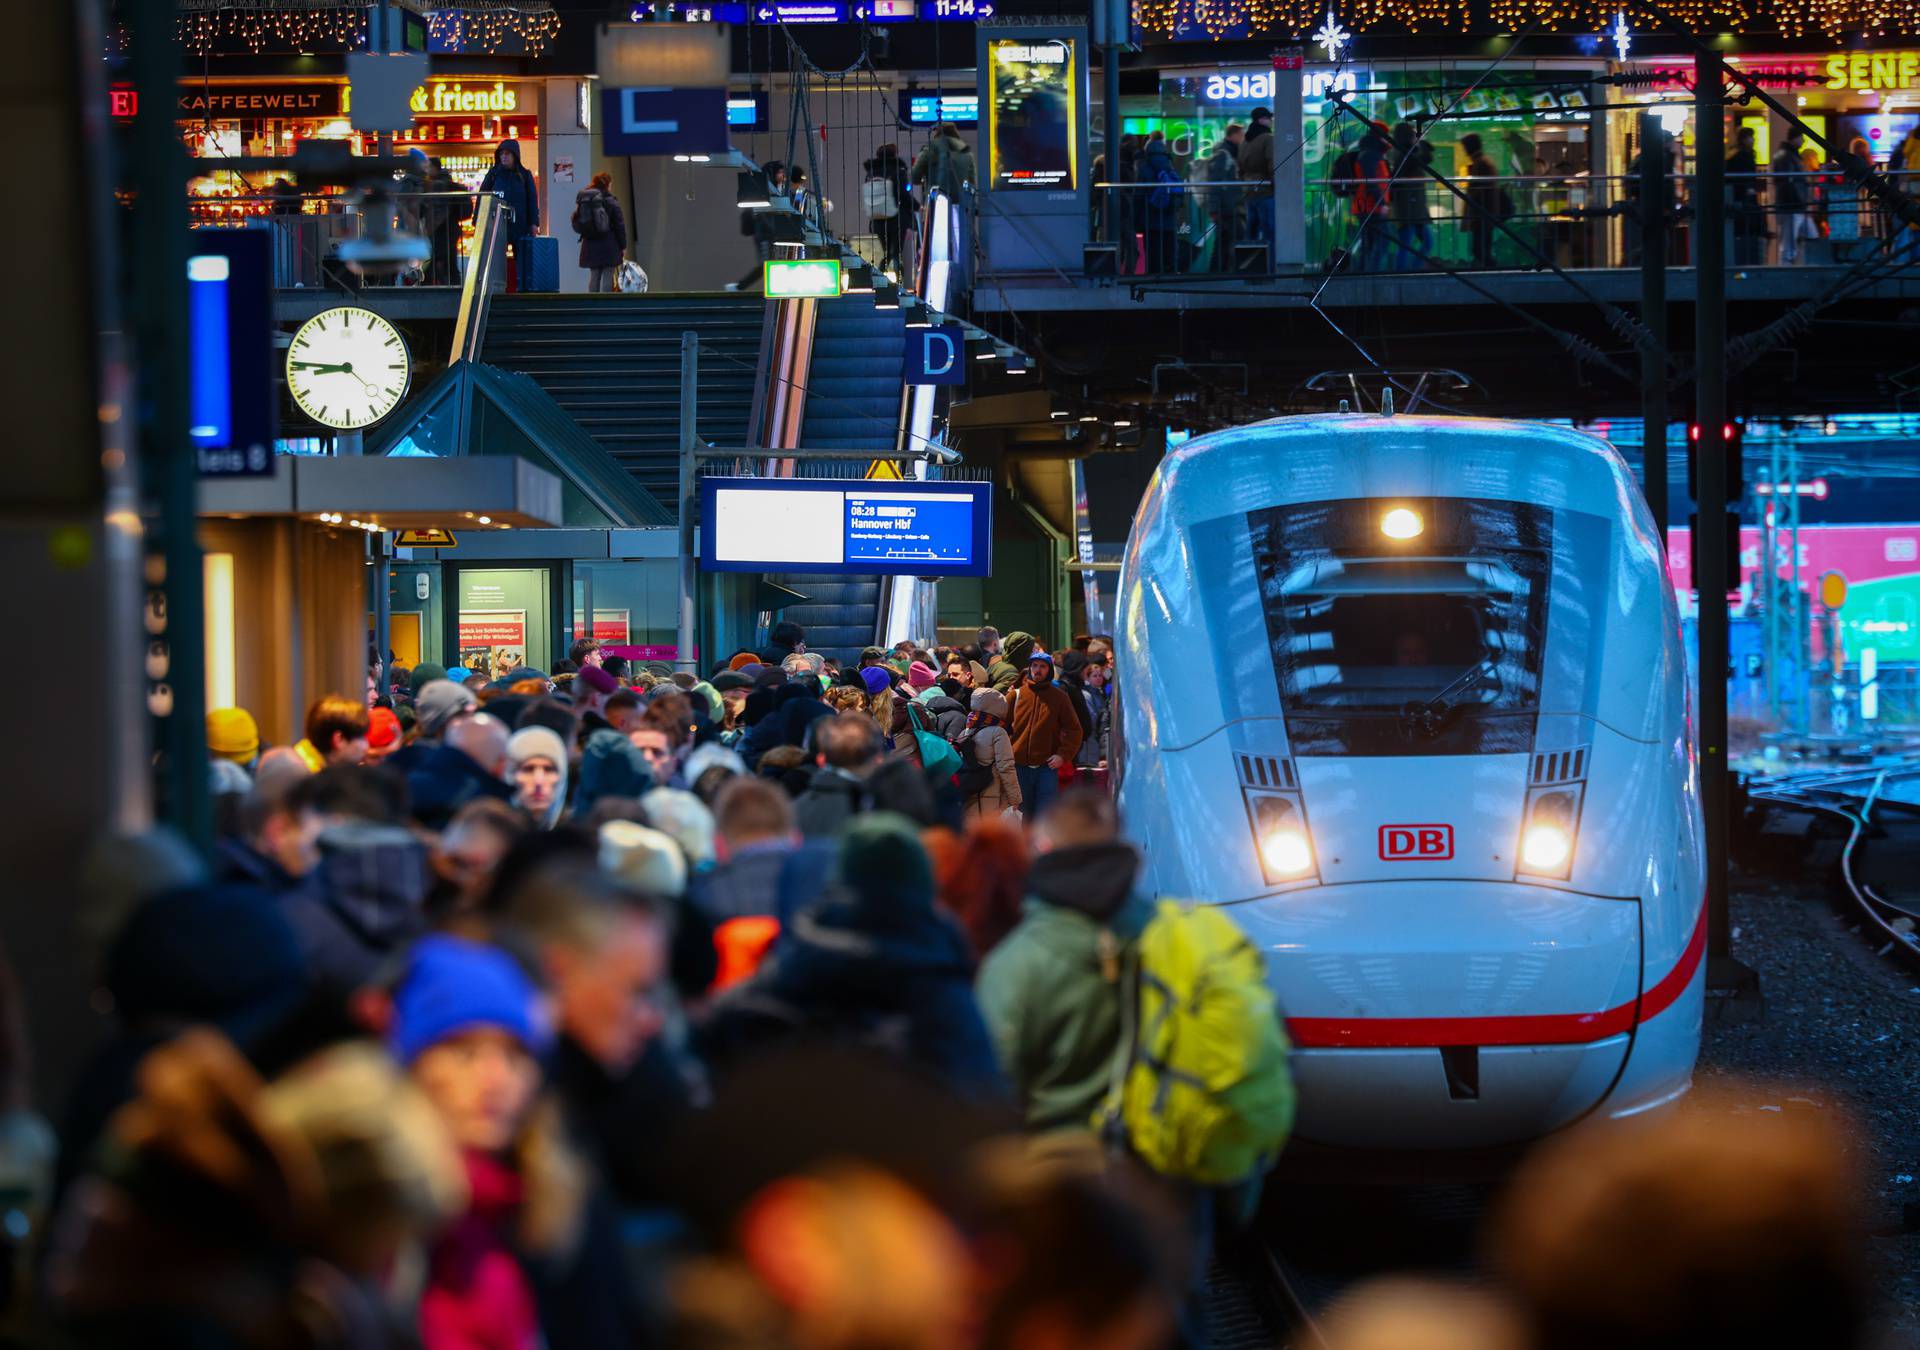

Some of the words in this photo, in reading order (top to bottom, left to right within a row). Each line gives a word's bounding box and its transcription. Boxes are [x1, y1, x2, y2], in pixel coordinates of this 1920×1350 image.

[936, 0, 976, 16] 11-14
[177, 94, 321, 109] KAFFEEWELT
[410, 86, 429, 112] &
[433, 83, 516, 111] friends
[923, 332, 955, 374] D
[850, 506, 875, 517] 08:28
[851, 518, 893, 530] Hannover
[894, 519, 912, 530] Hbf
[1387, 829, 1446, 855] DB
